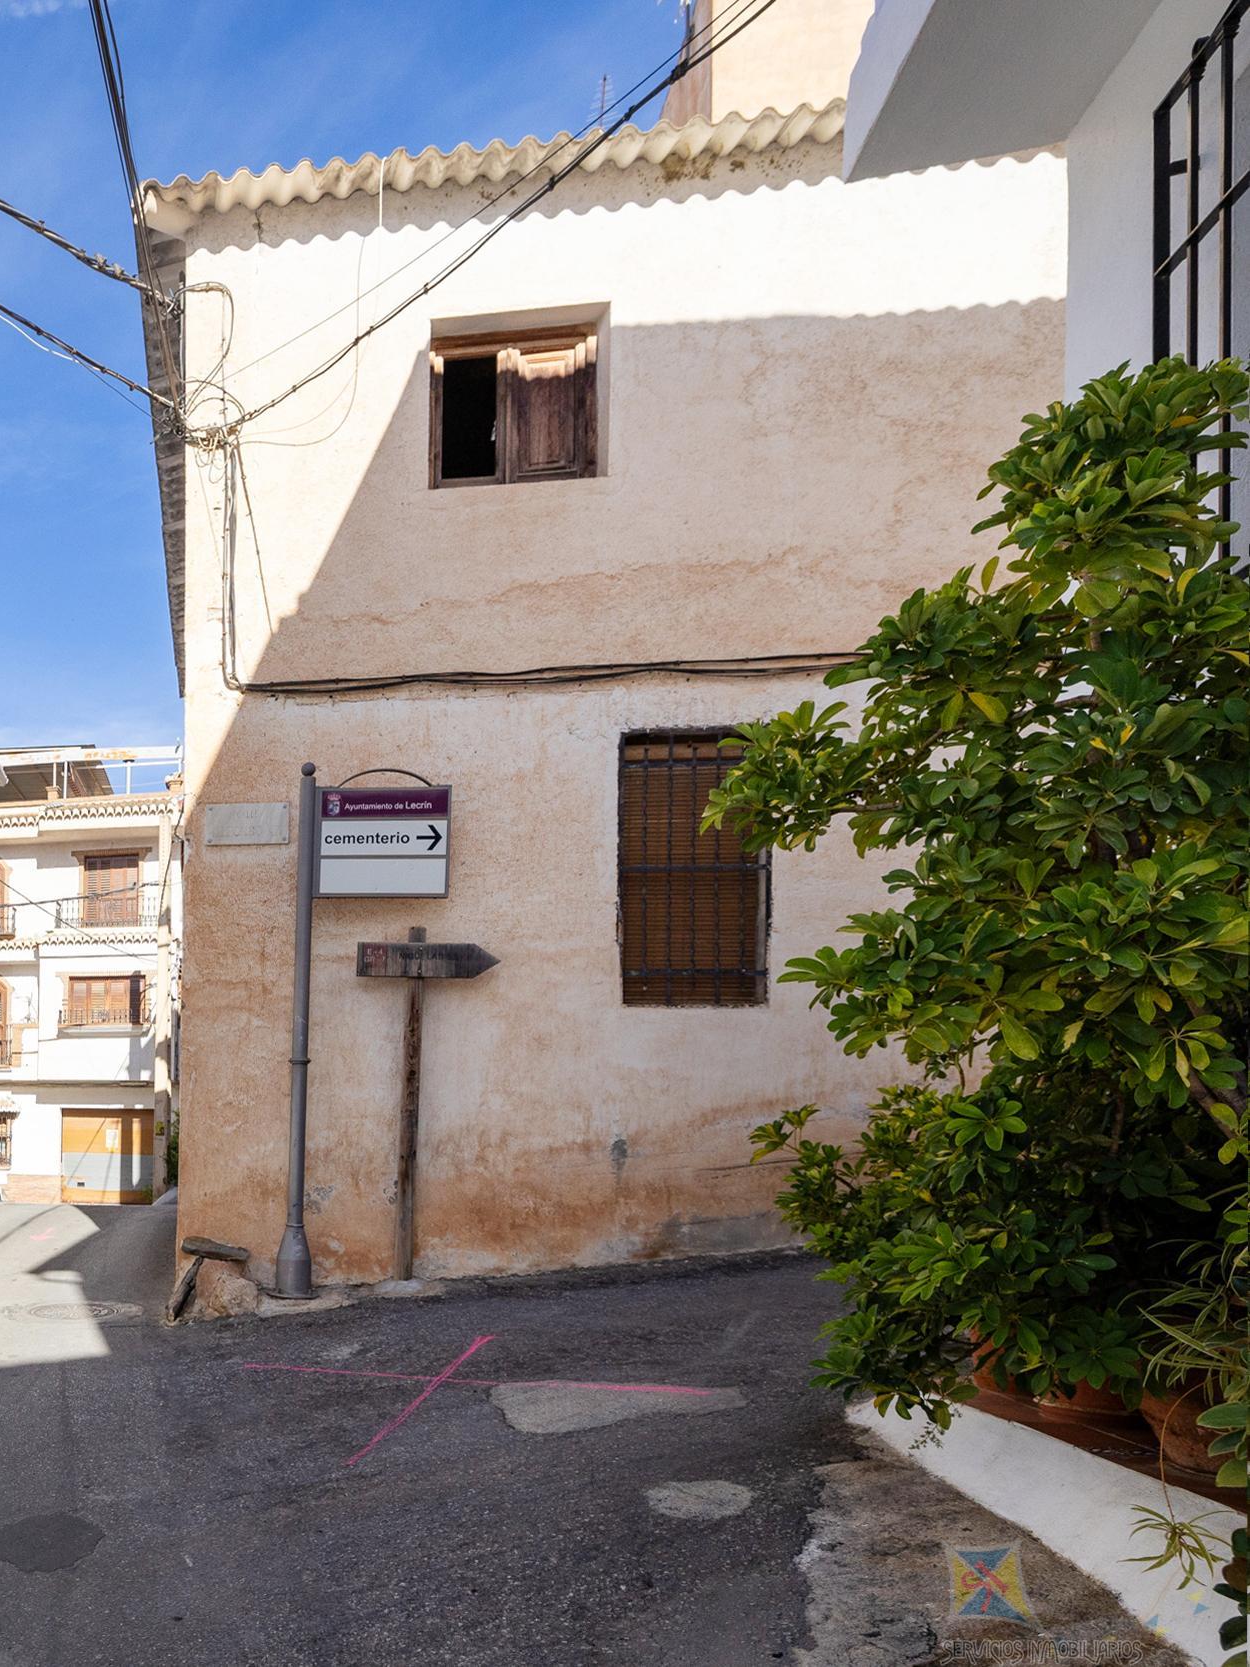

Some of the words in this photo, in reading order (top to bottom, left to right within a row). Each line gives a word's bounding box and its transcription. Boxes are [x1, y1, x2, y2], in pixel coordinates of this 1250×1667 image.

[344, 802, 392, 811] Ayuntamiento
[394, 801, 403, 810] de
[324, 832, 410, 844] cementerio
